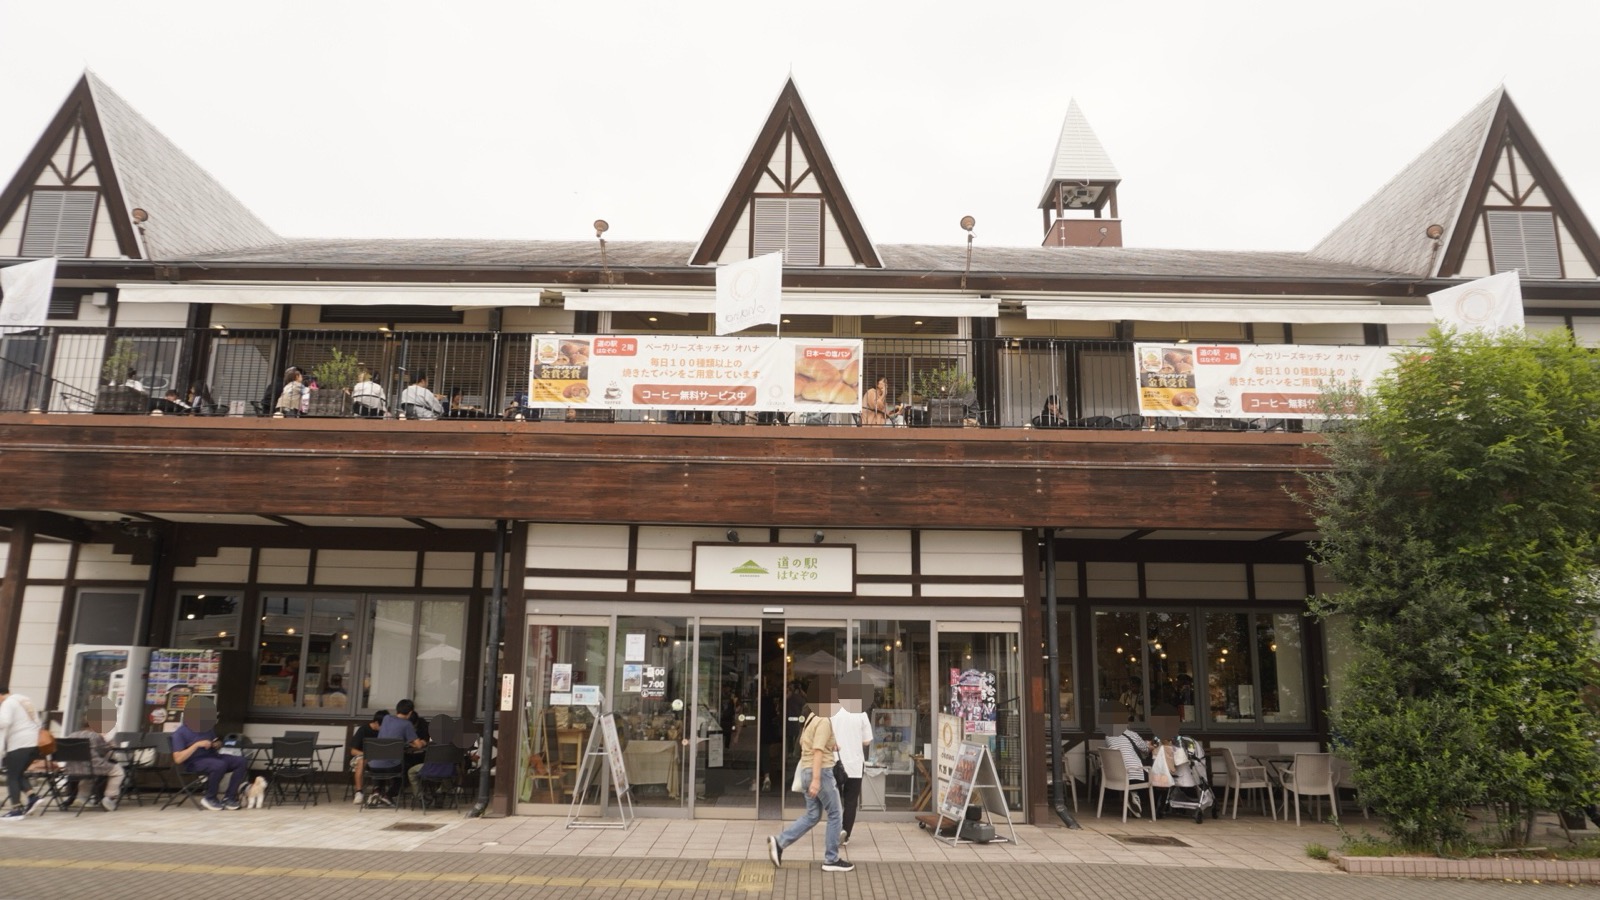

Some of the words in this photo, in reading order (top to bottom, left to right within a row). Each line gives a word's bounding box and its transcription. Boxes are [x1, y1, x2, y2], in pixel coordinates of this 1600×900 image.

[735, 344, 760, 353] オハナ
[806, 349, 851, 358] 日本一の塩パン
[1336, 353, 1360, 361] オハナ
[541, 369, 581, 379] 金賞受賞
[1148, 378, 1188, 388] 金賞受賞
[642, 389, 747, 401] コーヒー無料サービス中
[777, 556, 818, 569] 道の駅
[777, 570, 818, 581] はなぞの
